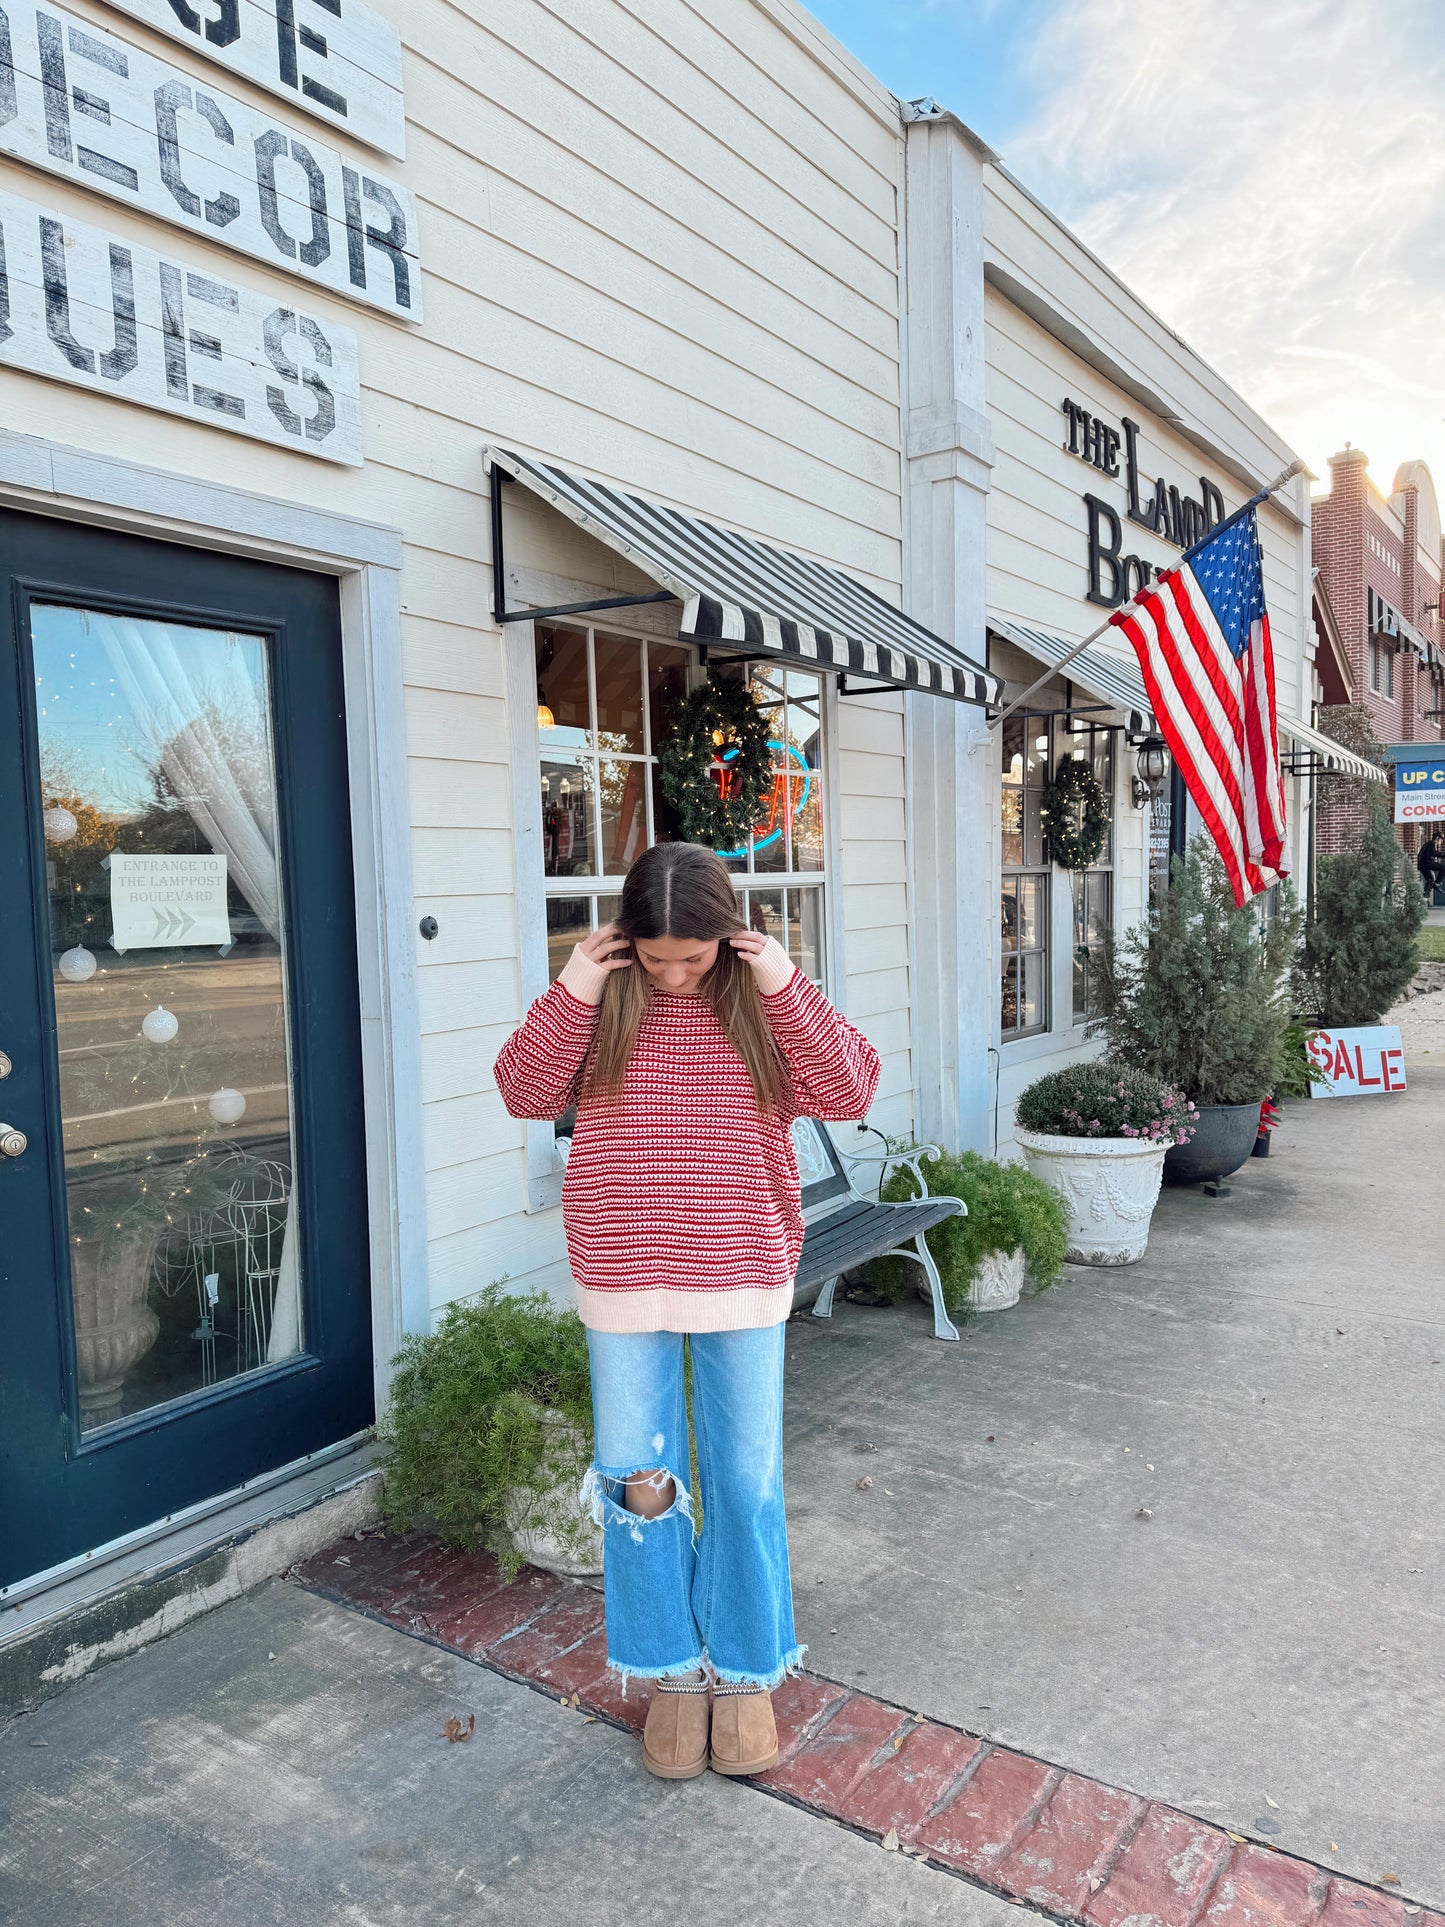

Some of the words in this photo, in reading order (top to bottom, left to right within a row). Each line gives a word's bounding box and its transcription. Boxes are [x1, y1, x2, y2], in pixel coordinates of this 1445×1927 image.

[0, 8, 411, 309] ECOR
[0, 215, 335, 442] UES
[1062, 398, 1121, 478] THE
[1402, 771, 1428, 784] UP
[118, 876, 145, 887] THE
[150, 875, 223, 887] LAMPPOST
[123, 860, 197, 871] ENTRANCE
[201, 860, 218, 871] TO
[129, 889, 213, 902] BOULEVARD
[1308, 1031, 1406, 1091] SALE
